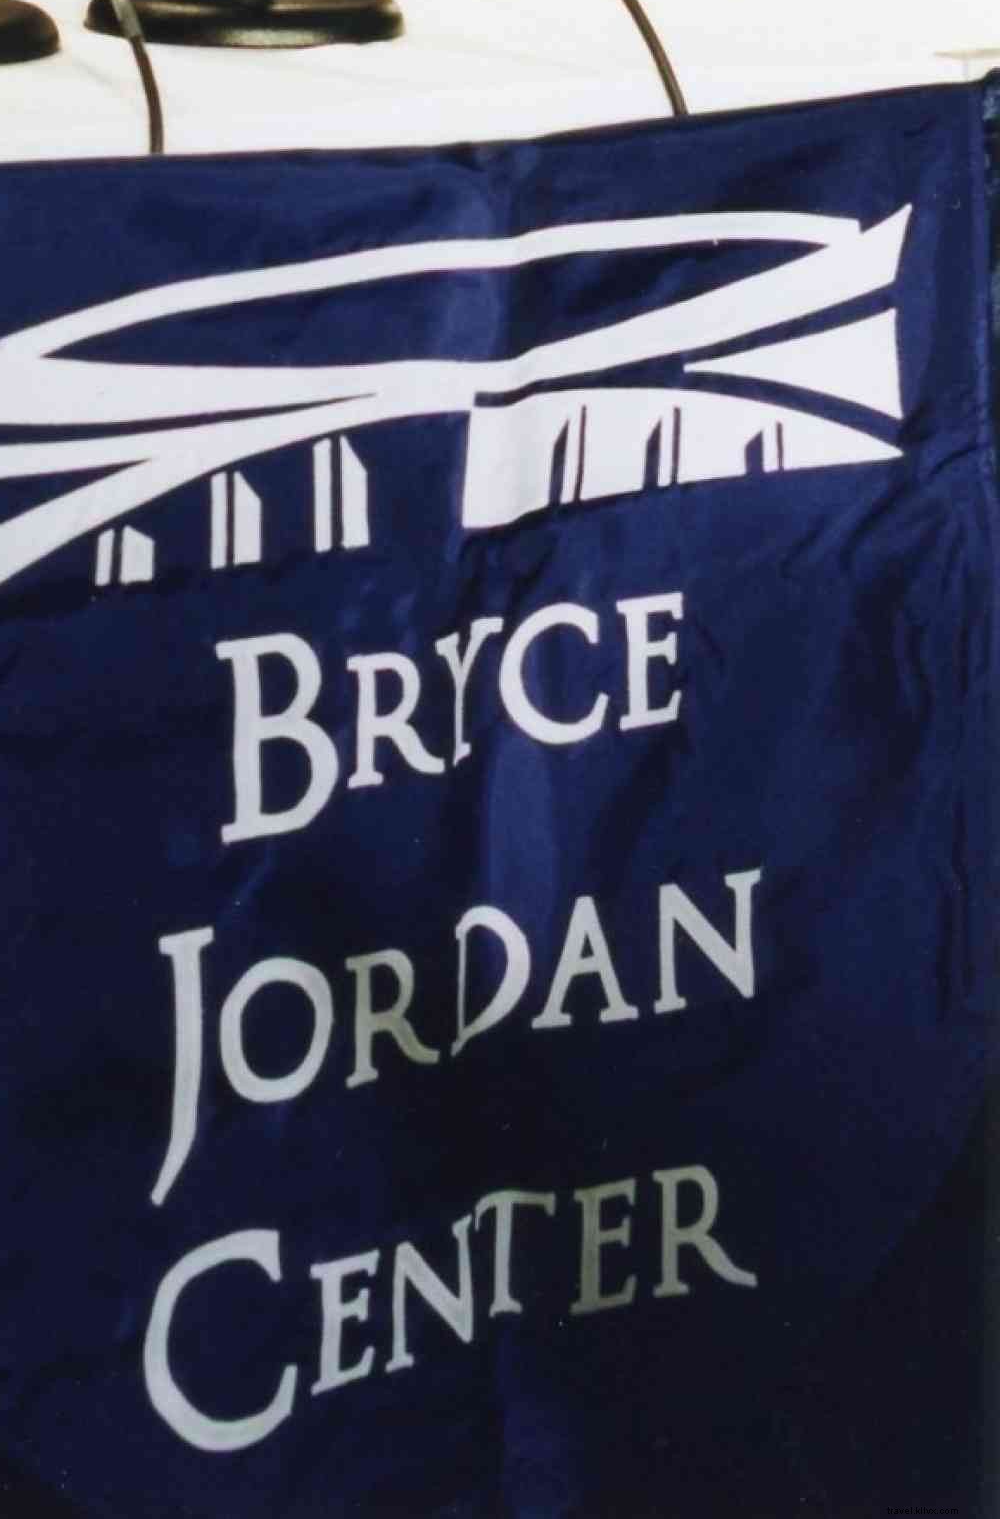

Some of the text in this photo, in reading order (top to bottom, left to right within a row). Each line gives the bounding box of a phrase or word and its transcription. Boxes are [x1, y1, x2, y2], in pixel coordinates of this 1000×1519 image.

[215, 591, 684, 845] BRYCE
[151, 869, 762, 1206] JORDAN
[143, 1166, 758, 1452] CENTER
